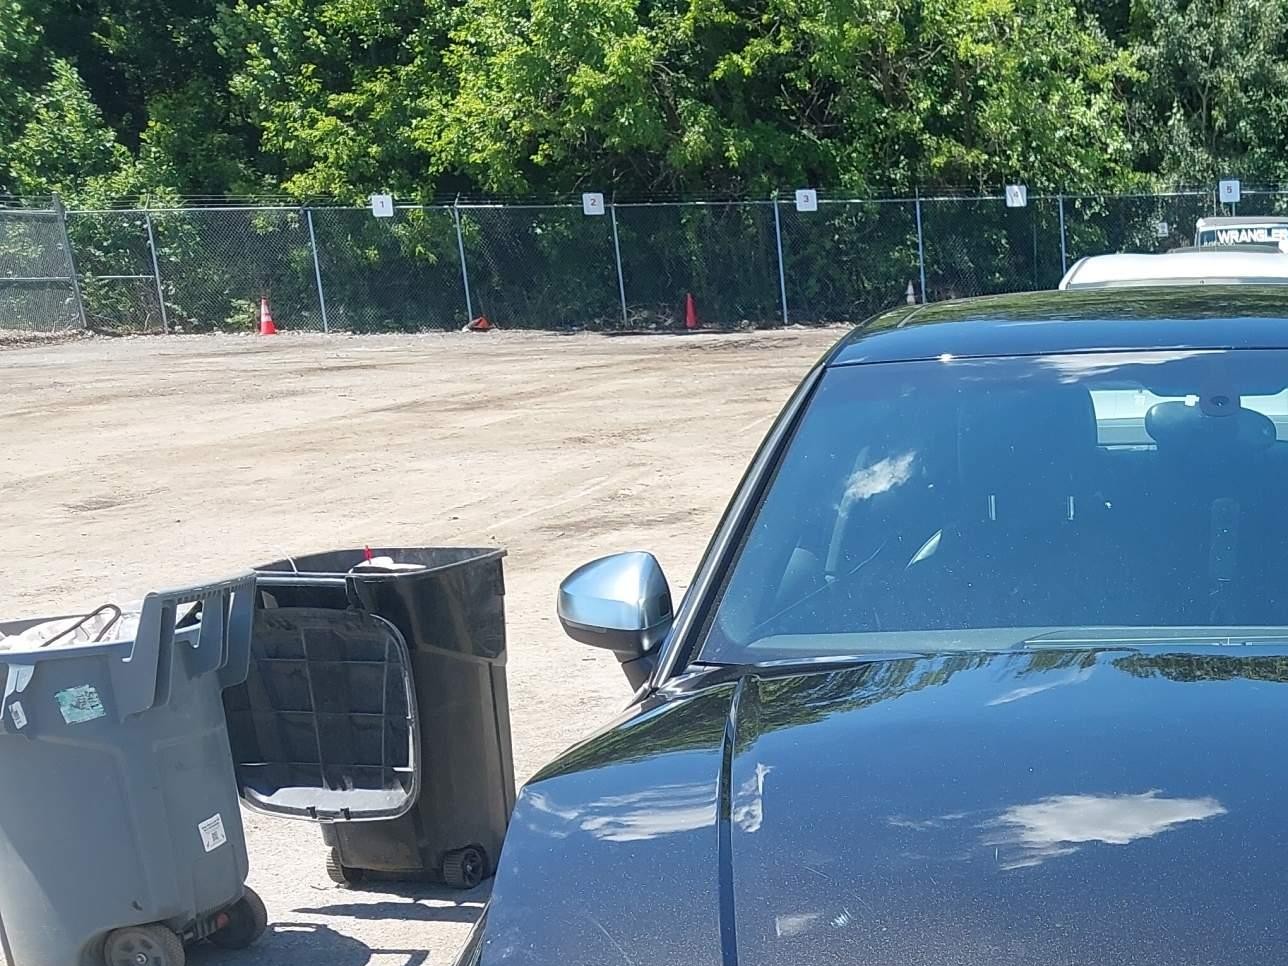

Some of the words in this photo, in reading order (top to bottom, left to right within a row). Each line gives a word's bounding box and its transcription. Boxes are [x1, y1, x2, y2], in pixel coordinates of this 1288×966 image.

[380, 200, 385, 208] 1
[590, 198, 597, 206] 2
[1216, 228, 1288, 243] WRANGLER
